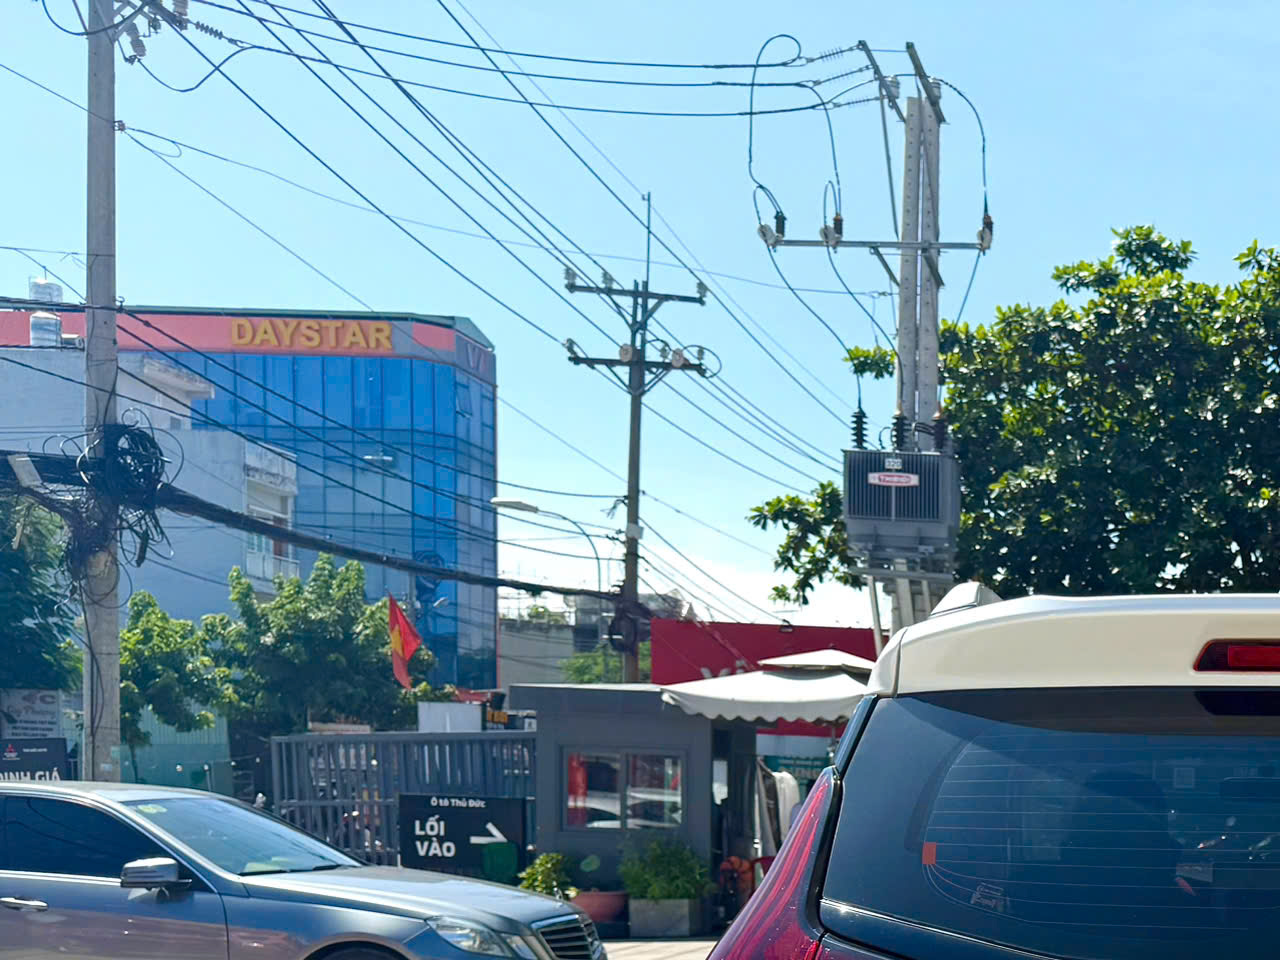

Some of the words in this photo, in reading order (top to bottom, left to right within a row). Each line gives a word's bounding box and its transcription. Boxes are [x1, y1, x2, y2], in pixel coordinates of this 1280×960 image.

[232, 318, 393, 349] DAYSTAR
[414, 814, 445, 836] LỐI
[415, 837, 456, 857] VÀO
